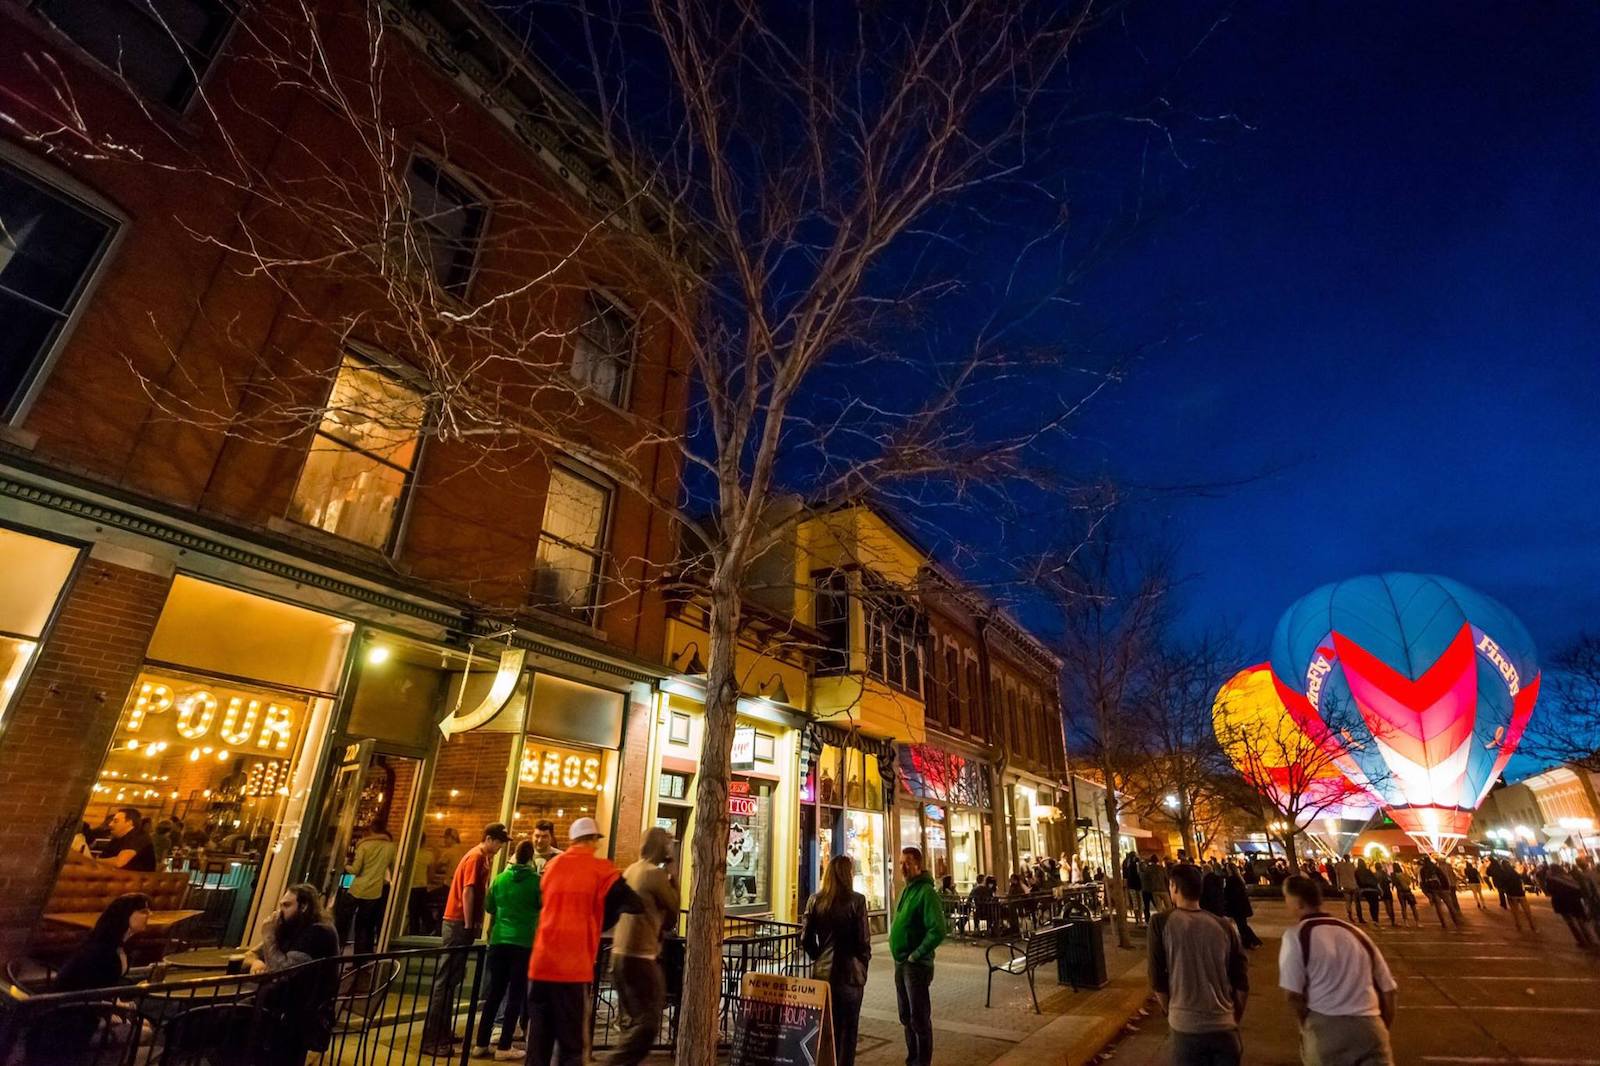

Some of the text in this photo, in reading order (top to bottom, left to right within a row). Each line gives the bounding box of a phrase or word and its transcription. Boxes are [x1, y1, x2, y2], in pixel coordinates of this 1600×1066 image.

[1476, 634, 1520, 697] FireFly
[125, 681, 294, 750] POUR
[520, 748, 602, 791] BROS.
[729, 799, 757, 815] TTOO
[748, 979, 816, 995] NEW BELGIUM
[763, 991, 798, 999] BREWING
[779, 1005, 807, 1027] HOUR
